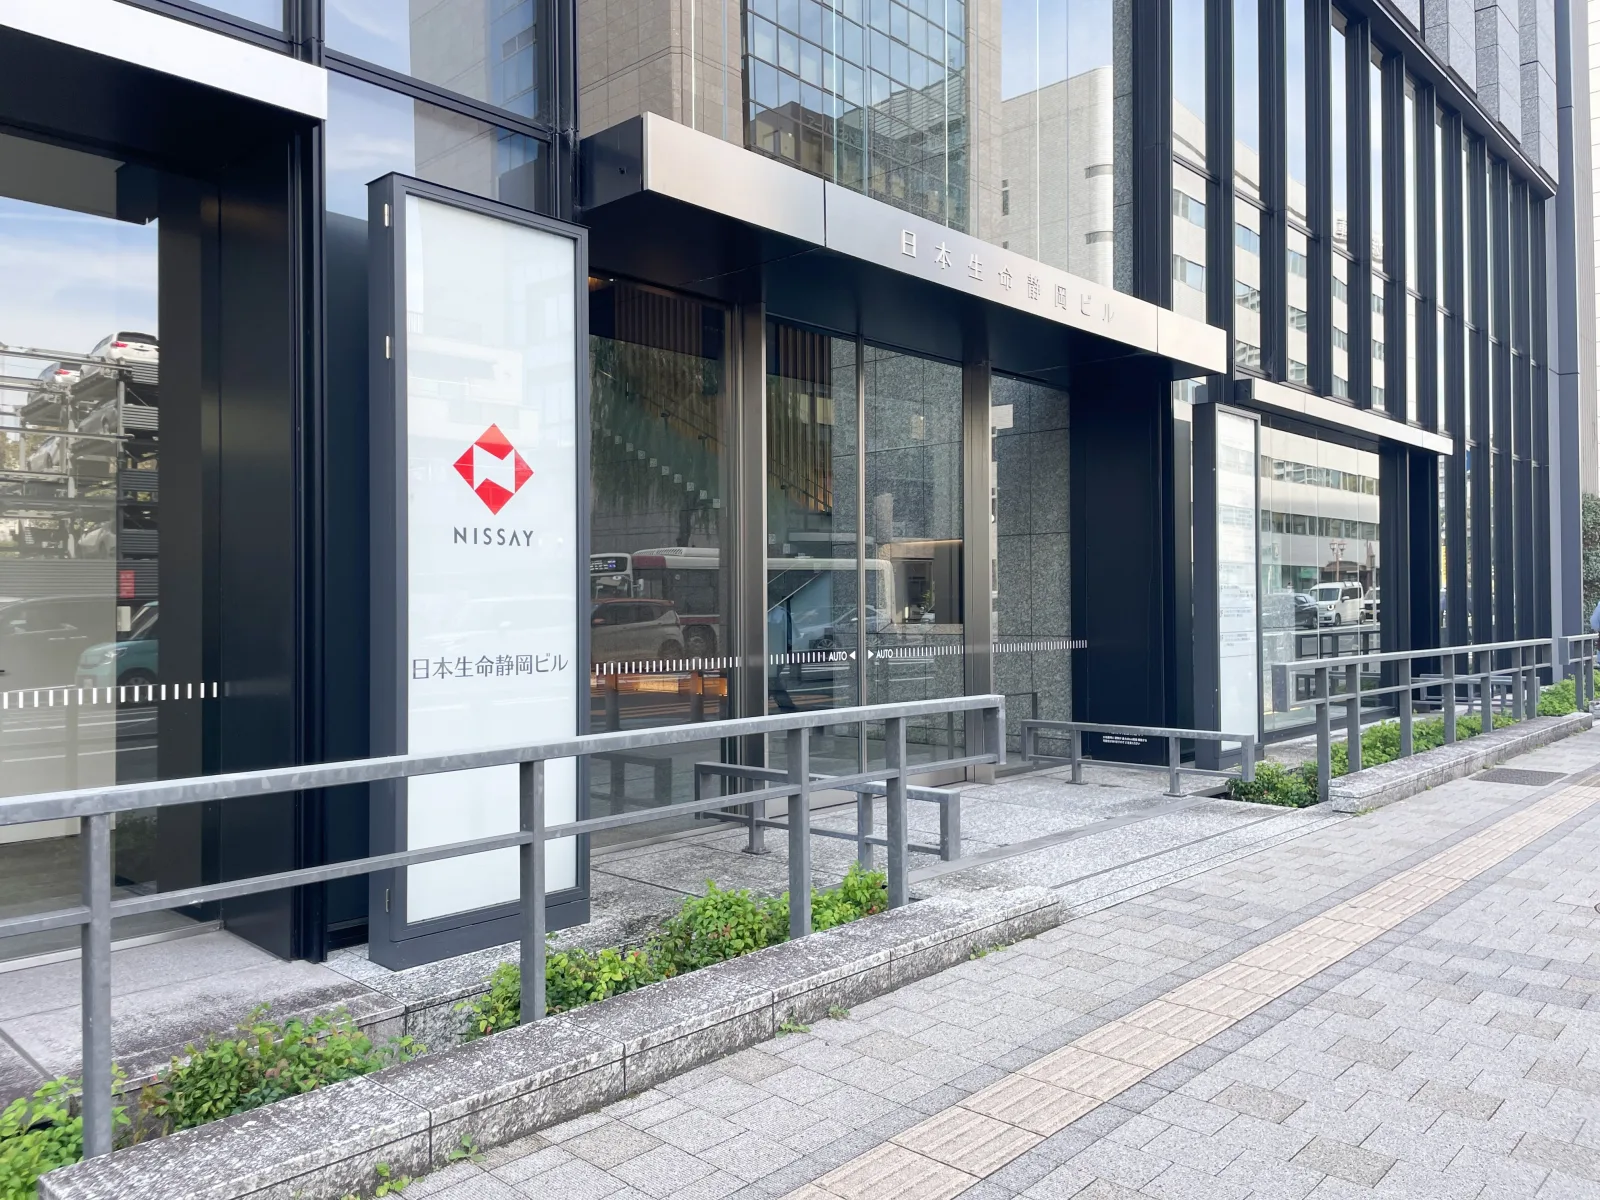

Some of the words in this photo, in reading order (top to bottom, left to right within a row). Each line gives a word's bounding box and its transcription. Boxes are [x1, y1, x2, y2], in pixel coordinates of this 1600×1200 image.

[900, 228, 1115, 323] 日本生命静岡ビル
[453, 526, 534, 547] NISSAY
[829, 651, 848, 661] AUTO
[876, 649, 894, 659] AUTO
[412, 653, 569, 680] 日本生命静岡ビル
